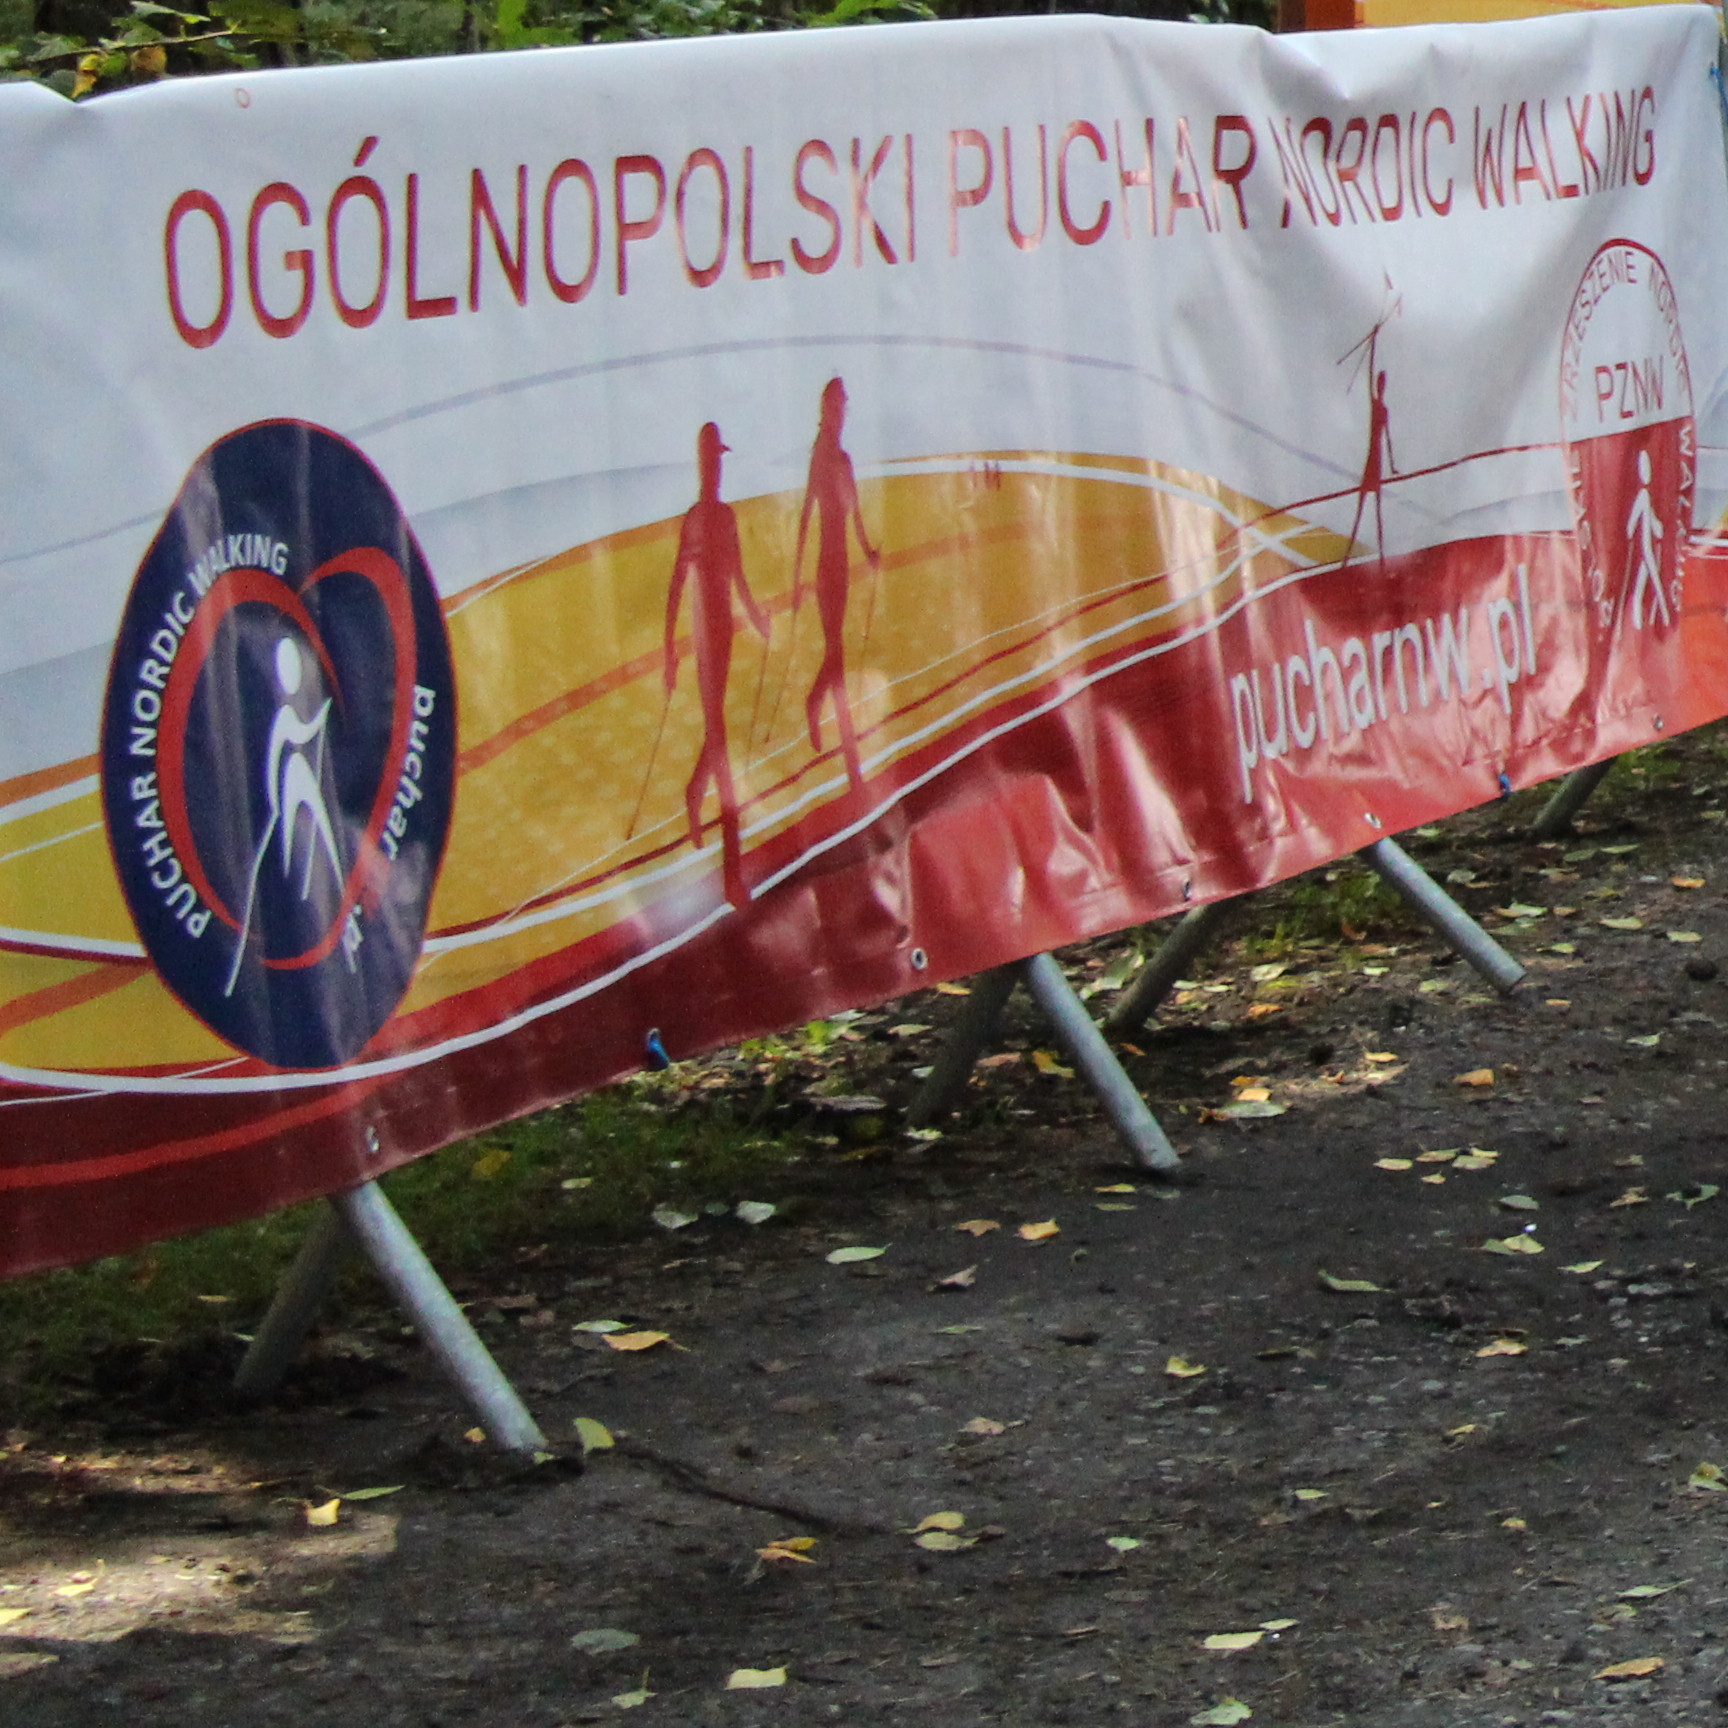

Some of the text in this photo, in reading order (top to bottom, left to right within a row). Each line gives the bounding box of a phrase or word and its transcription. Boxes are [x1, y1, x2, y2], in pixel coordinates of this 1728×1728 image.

[164, 84, 1658, 349] OGÓLNOPOLSKI PUCHAR NORDIC WALKING
[1594, 353, 1665, 424] PZNW
[129, 532, 290, 940] PUCHAR NORDIC WALKING
[1230, 563, 1538, 803] pucharnw.pl
